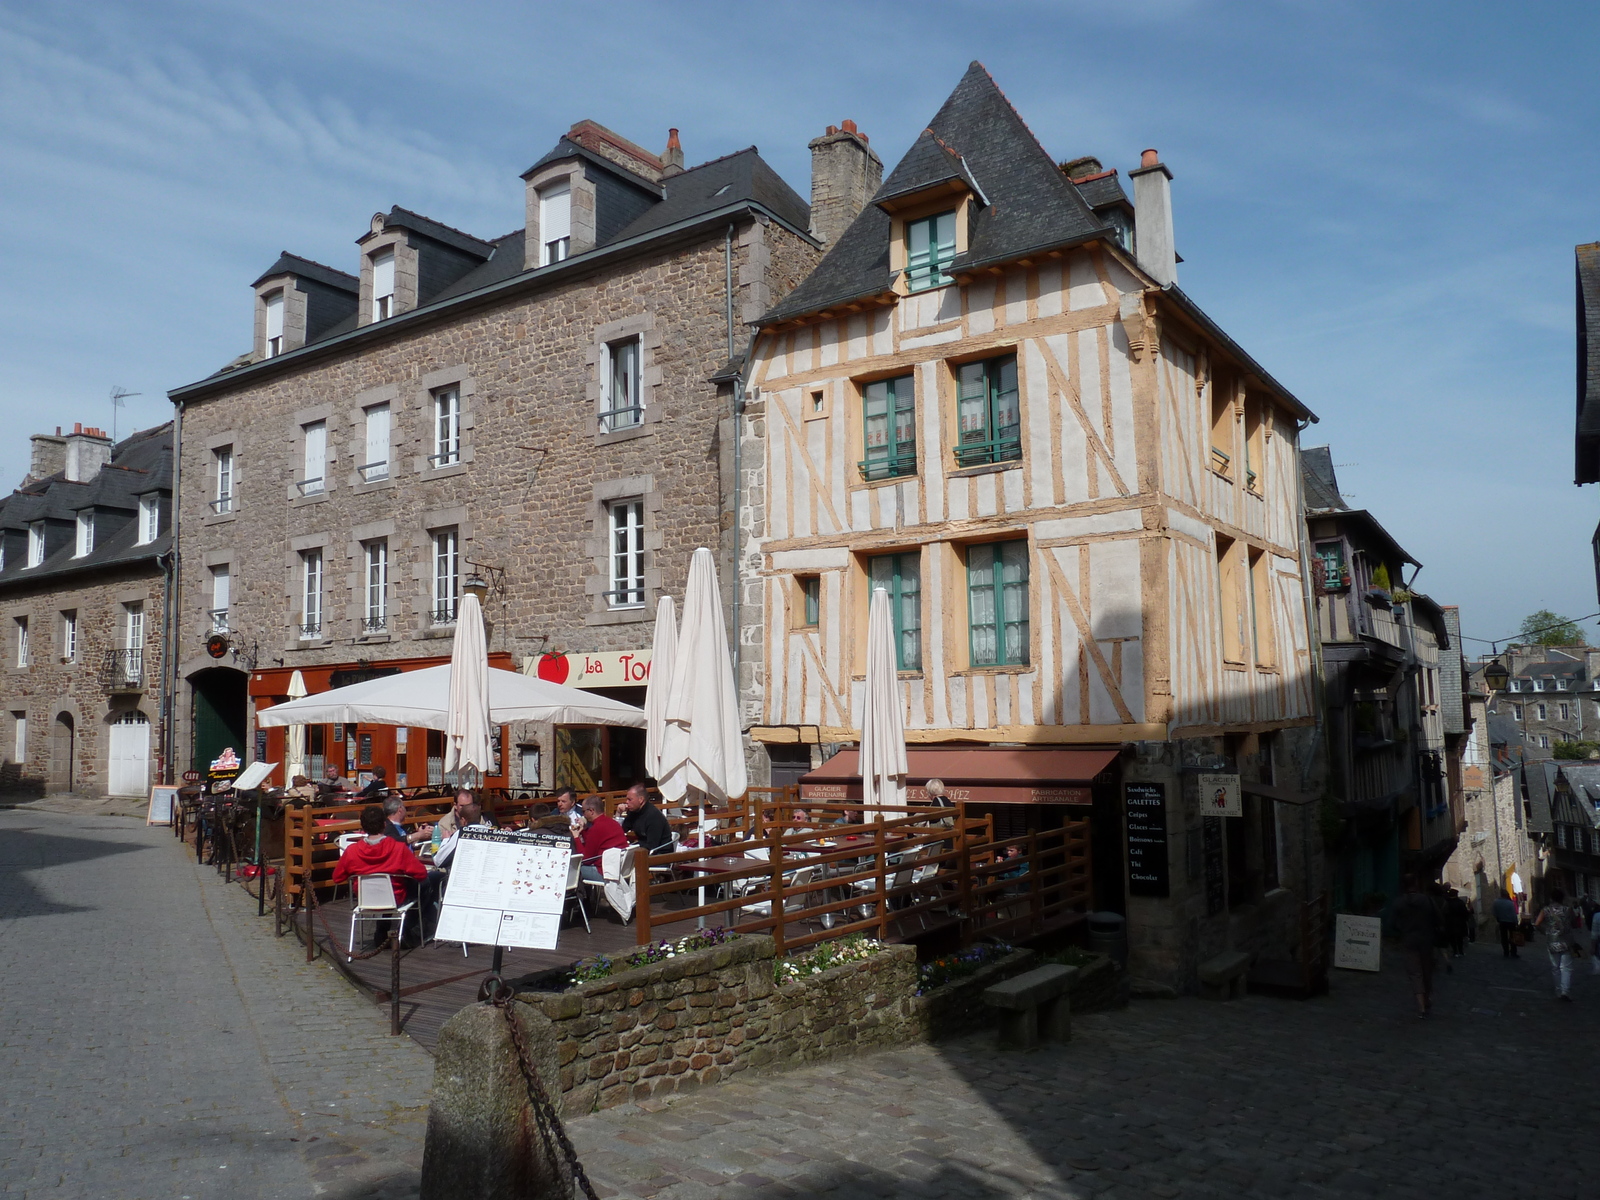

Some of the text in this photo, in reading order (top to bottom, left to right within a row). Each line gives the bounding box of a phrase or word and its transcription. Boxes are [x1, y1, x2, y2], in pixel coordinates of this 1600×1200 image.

[585, 653, 651, 681] La To
[463, 826, 488, 834] GLACIER
